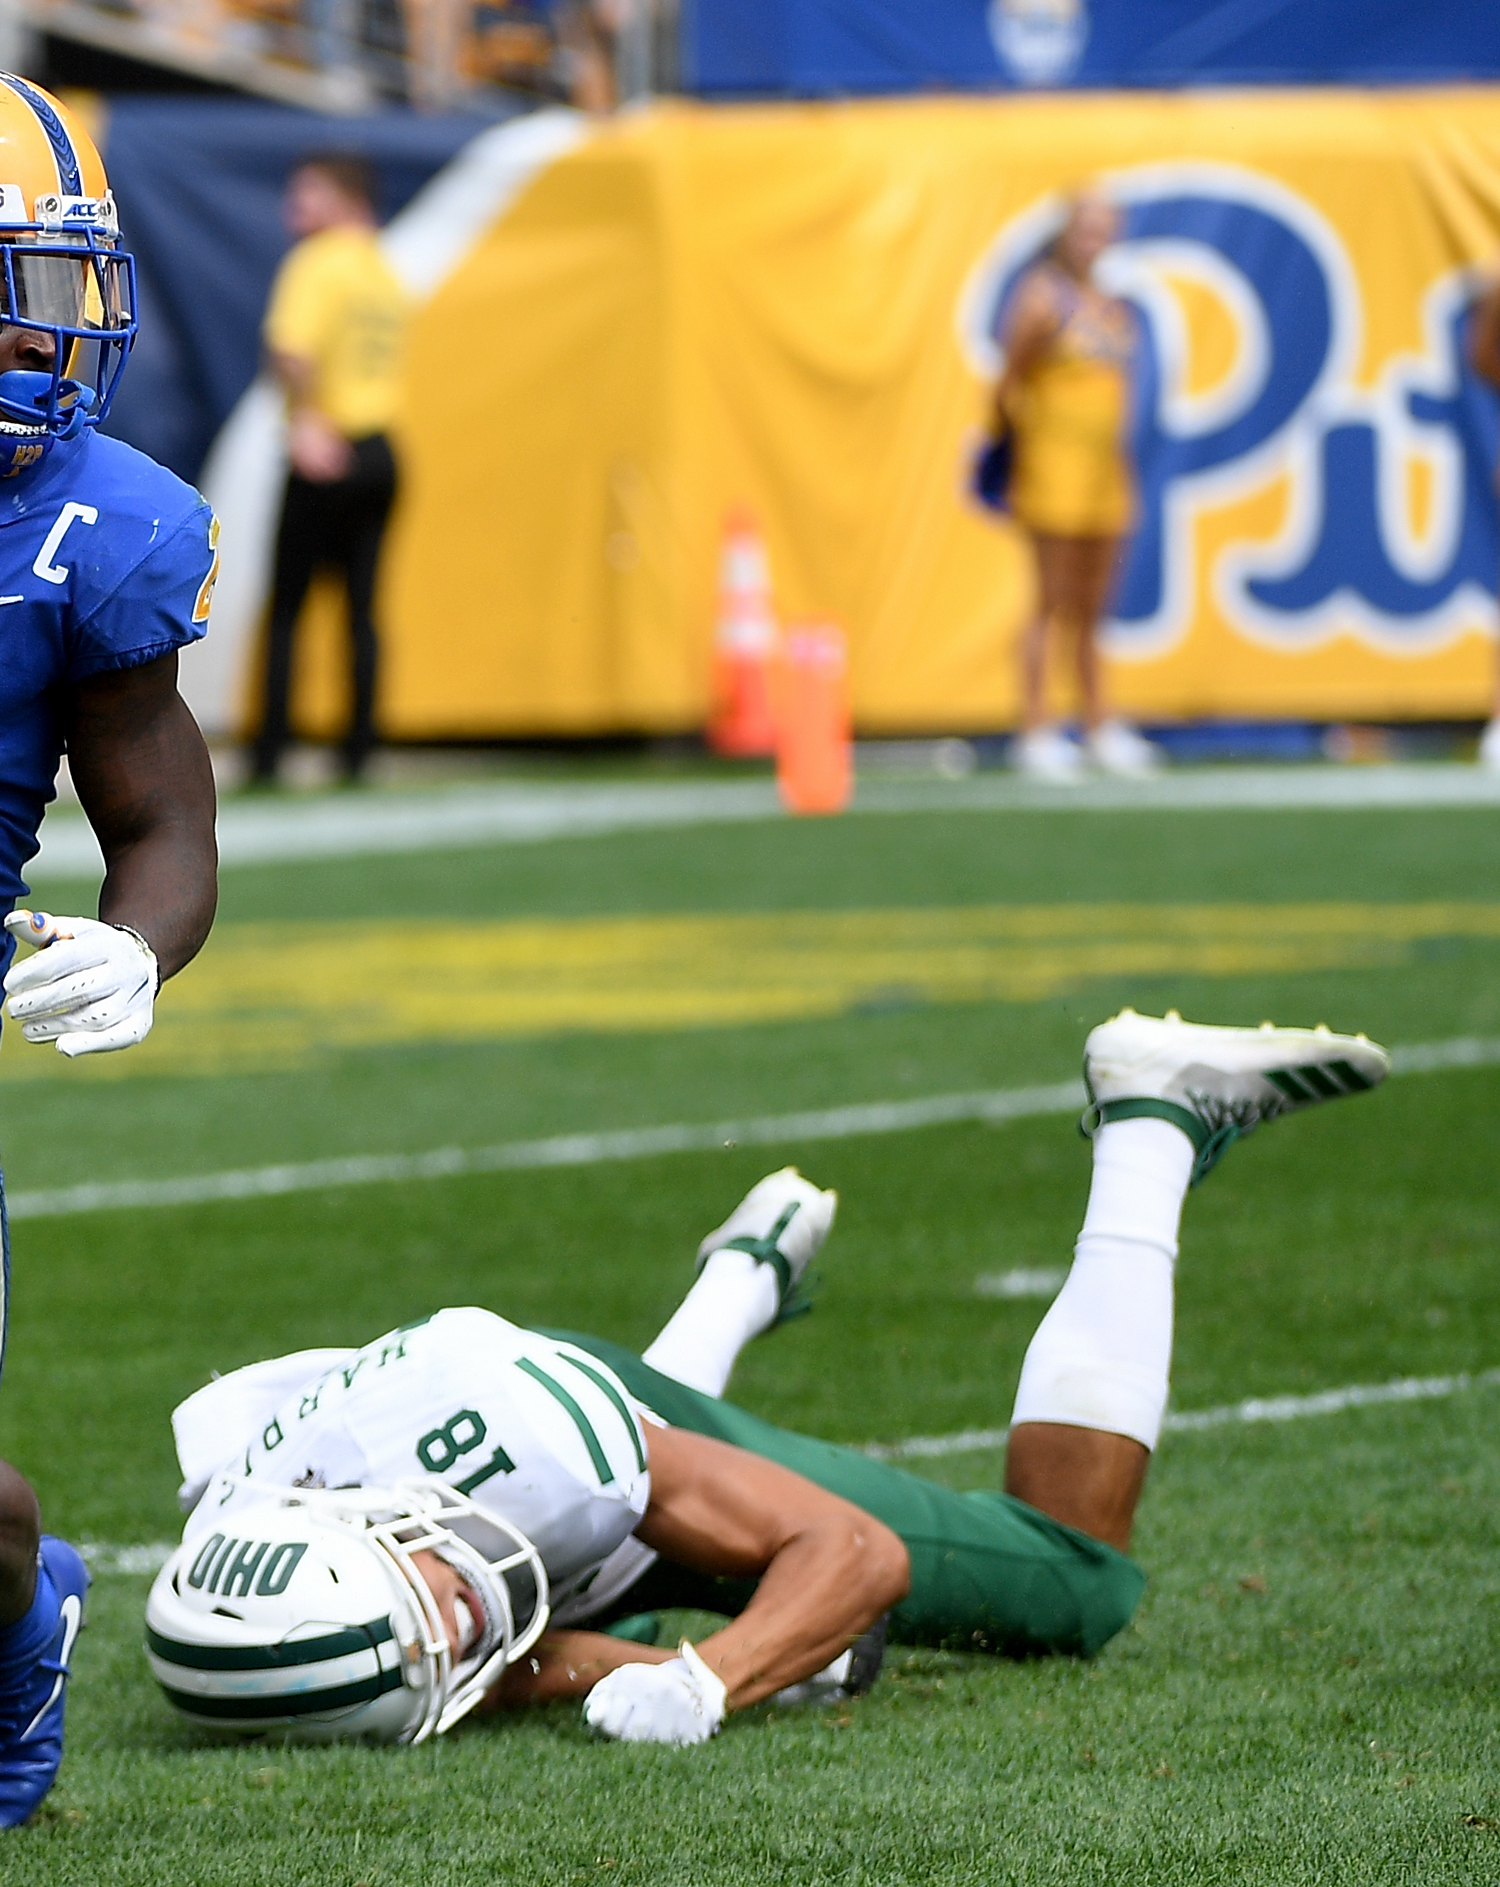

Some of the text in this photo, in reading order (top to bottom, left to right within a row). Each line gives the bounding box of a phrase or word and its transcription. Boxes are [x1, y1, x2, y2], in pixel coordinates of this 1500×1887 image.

[63, 203, 98, 217] ACC
[32, 501, 99, 585] C
[416, 1408, 517, 1500] 18
[187, 1532, 309, 1597] OHIO
